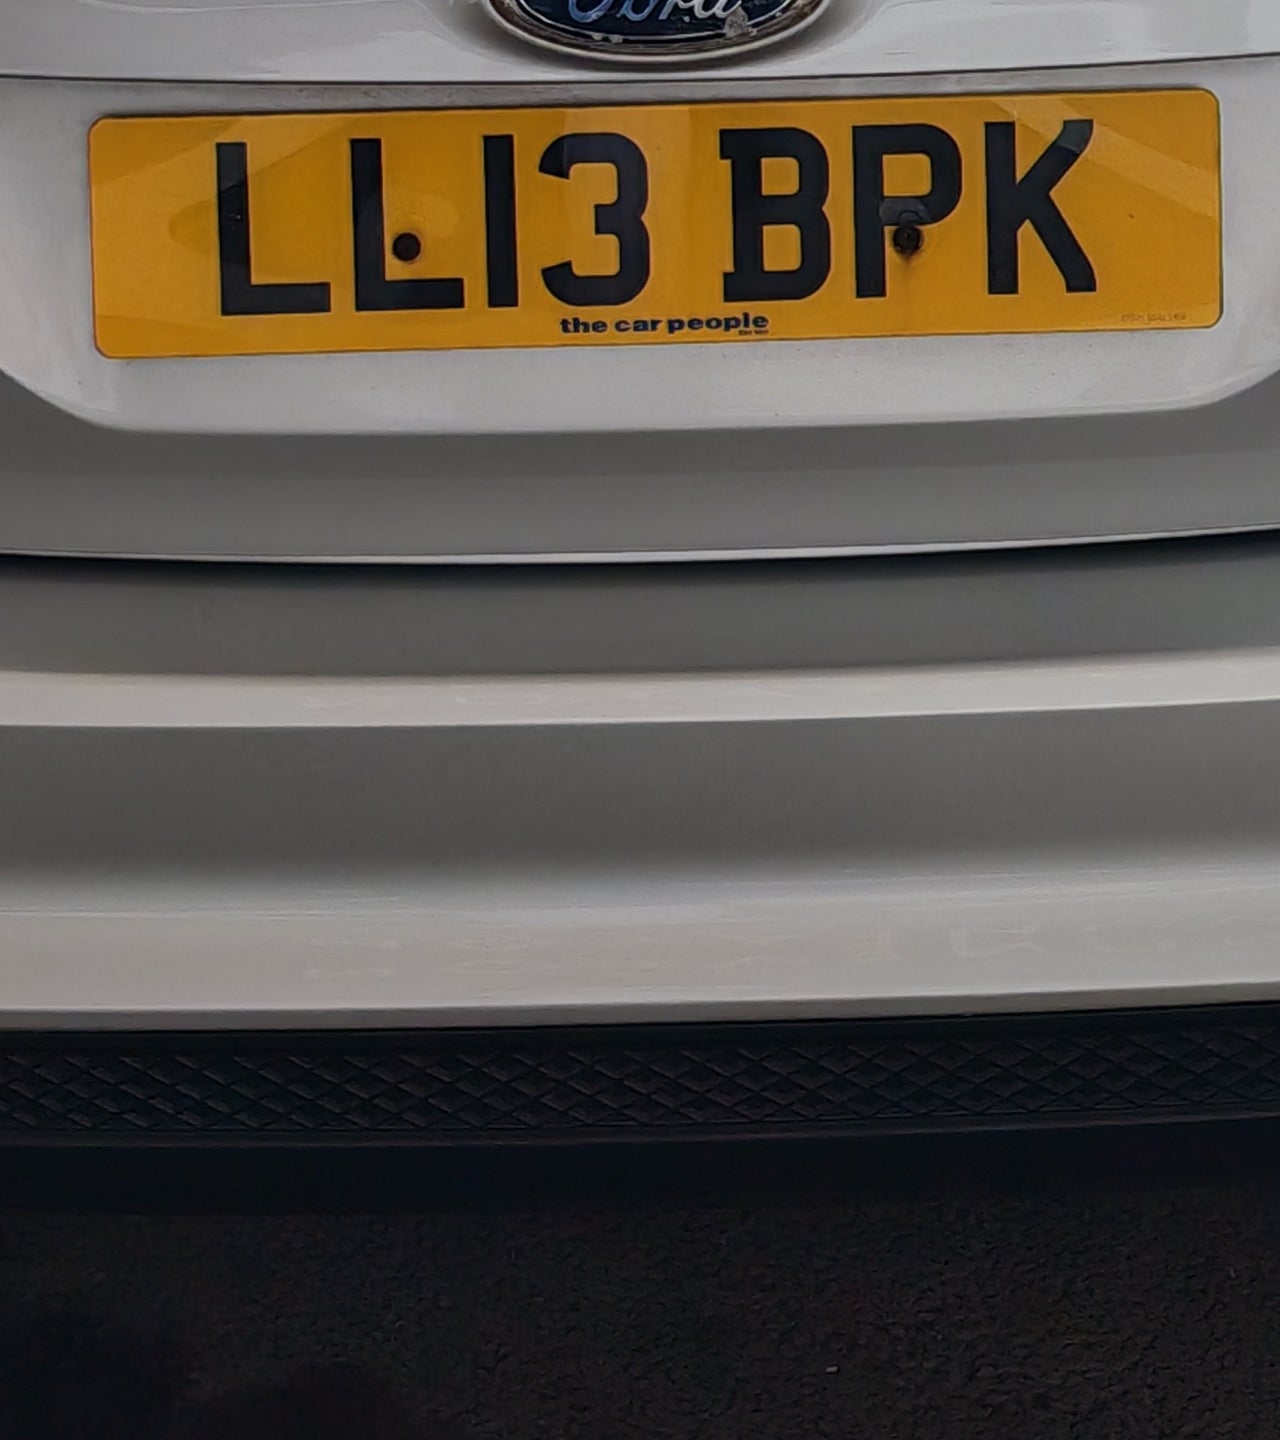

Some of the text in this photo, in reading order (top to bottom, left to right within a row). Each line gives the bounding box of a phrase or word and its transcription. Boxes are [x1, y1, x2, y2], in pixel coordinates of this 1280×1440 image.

[214, 118, 1098, 316] LL13 BPK
[560, 316, 608, 334] the
[614, 318, 663, 333] car
[666, 311, 770, 335] people
